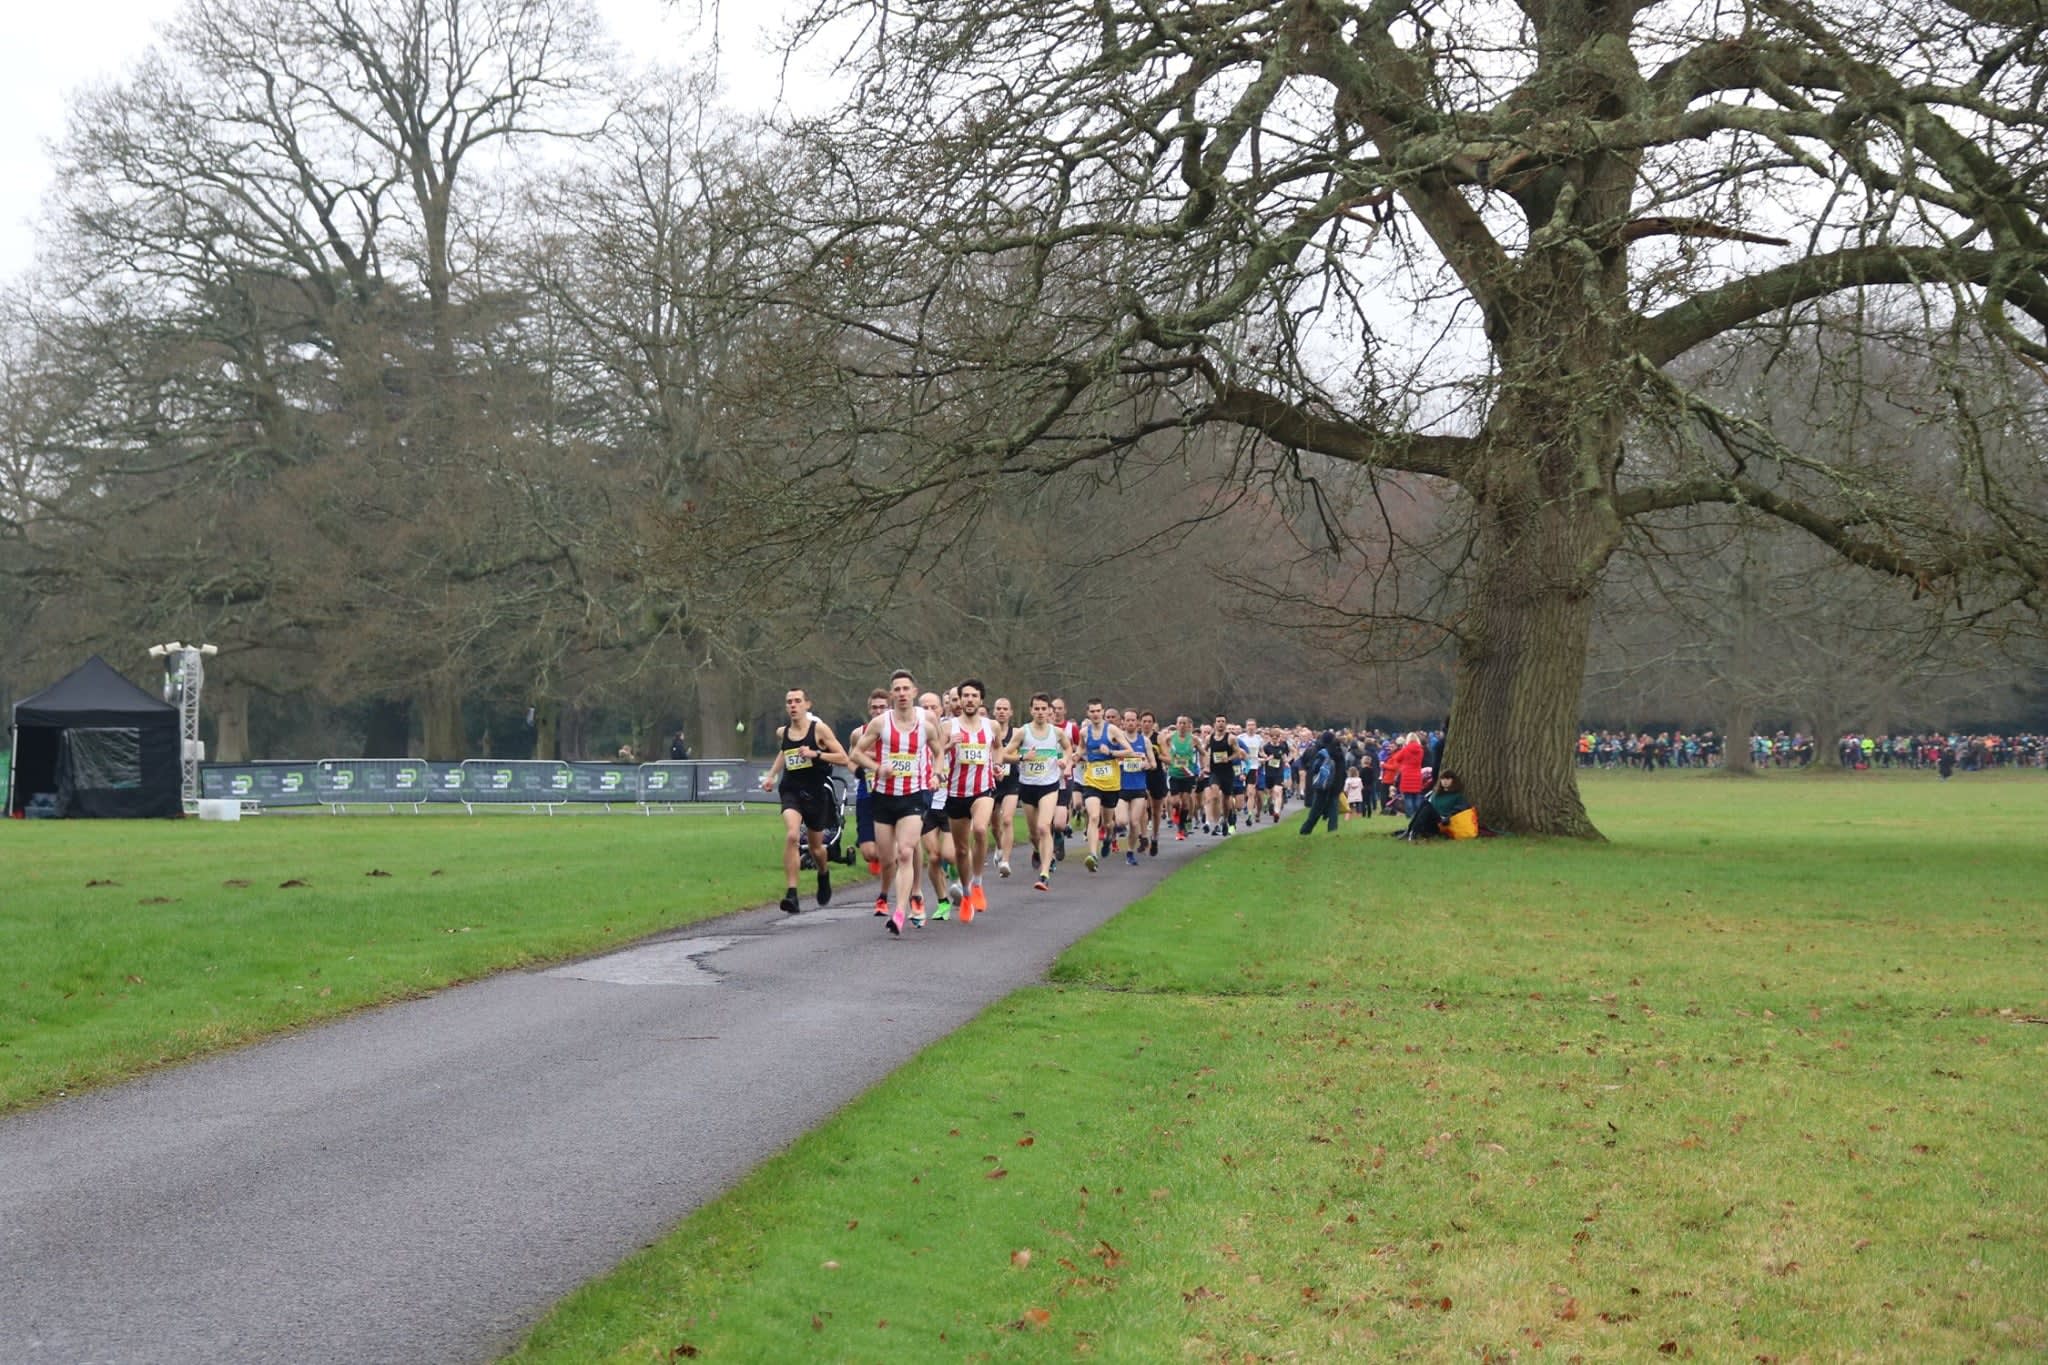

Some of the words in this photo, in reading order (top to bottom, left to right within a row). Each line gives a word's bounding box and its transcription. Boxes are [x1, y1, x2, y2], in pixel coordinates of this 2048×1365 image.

[965, 750, 982, 760] 194
[892, 760, 910, 771] 258
[1029, 763, 1045, 771] 726
[1095, 767, 1108, 775] 551
